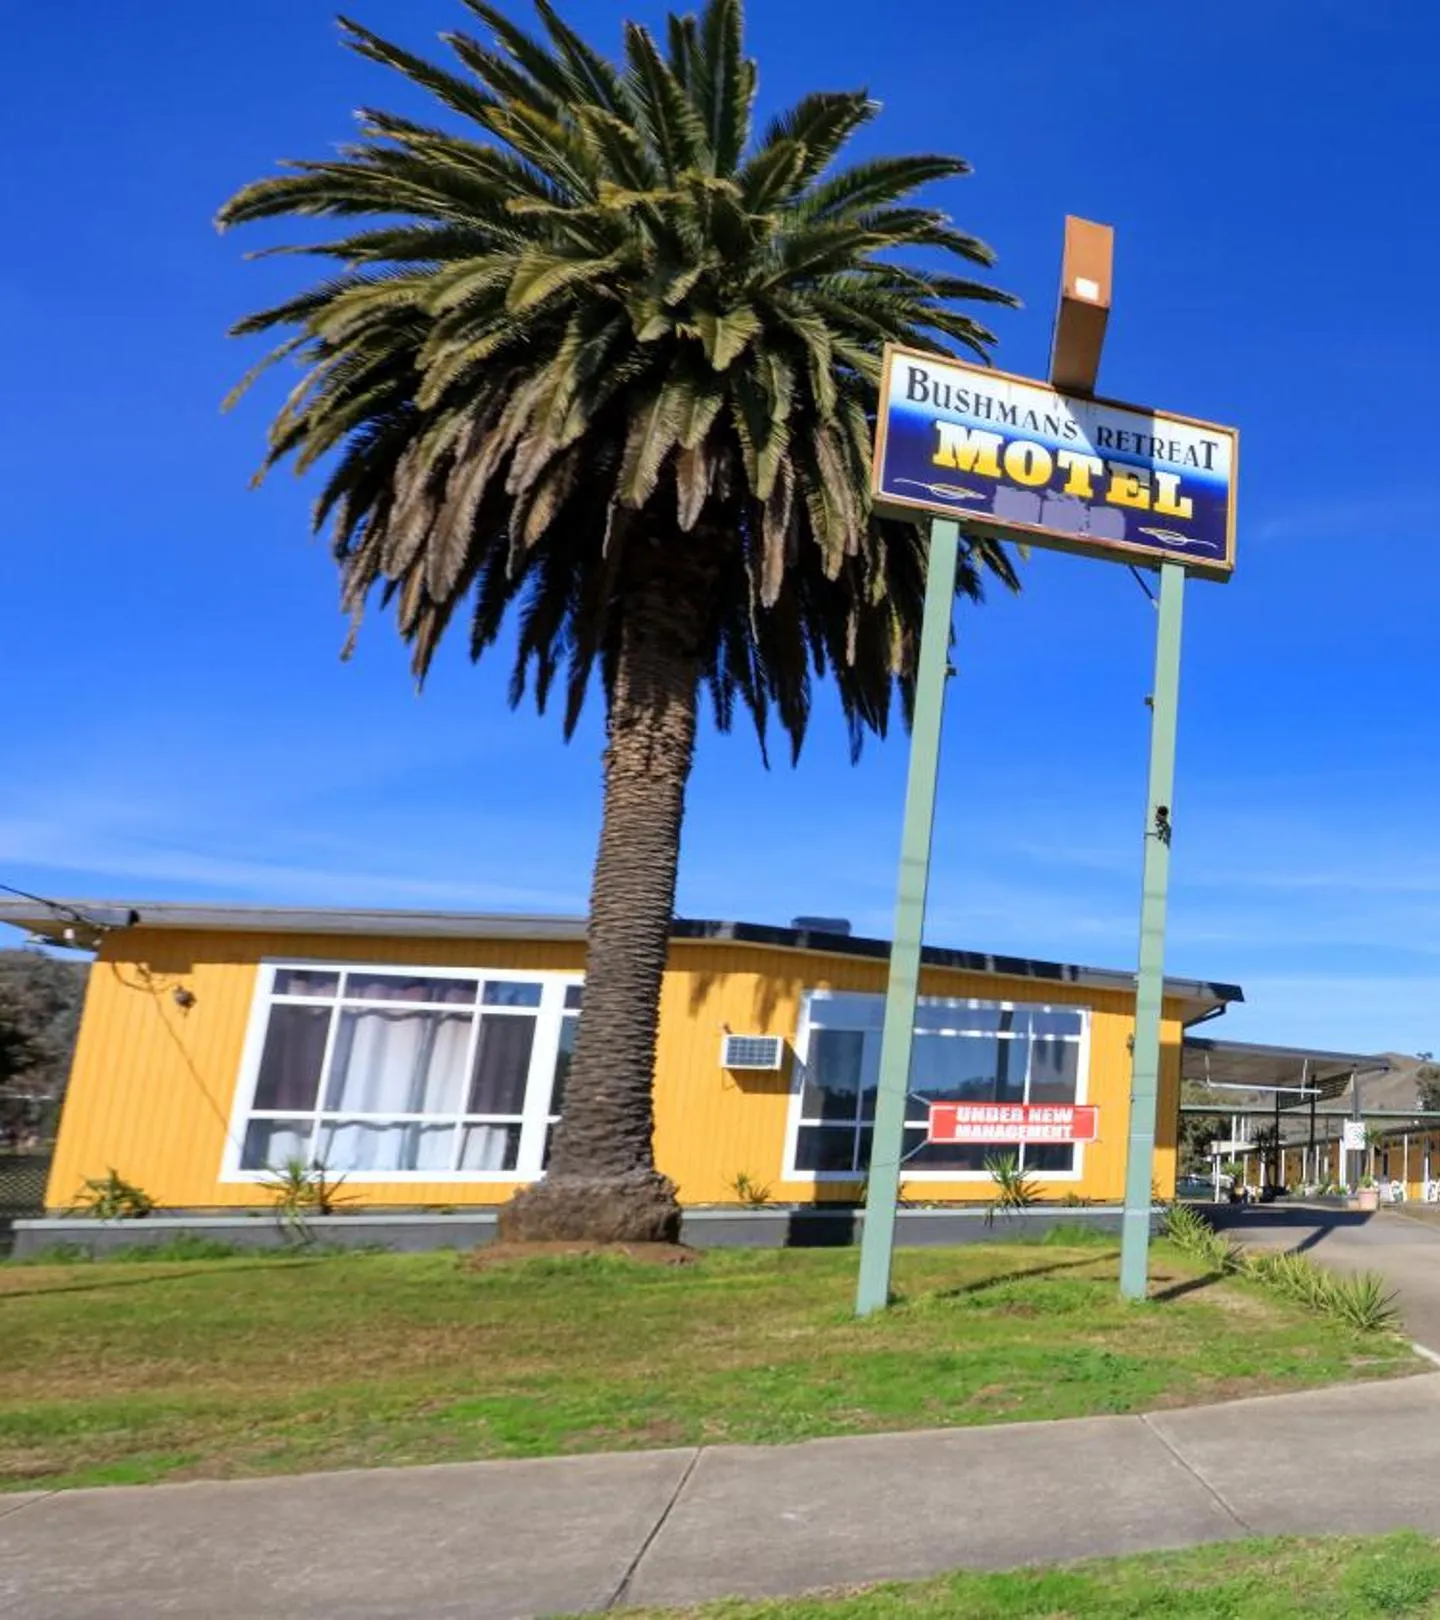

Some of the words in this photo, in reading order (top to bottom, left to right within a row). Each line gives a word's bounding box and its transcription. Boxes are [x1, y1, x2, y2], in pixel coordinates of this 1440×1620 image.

[905, 365, 1078, 441] BUSHMANS
[1096, 425, 1219, 471] RETREAT
[932, 419, 1193, 520] MOTEL
[955, 1106, 1024, 1122] UNDER
[1029, 1107, 1073, 1122] NEW
[955, 1124, 1073, 1138] MANAGEMENT
